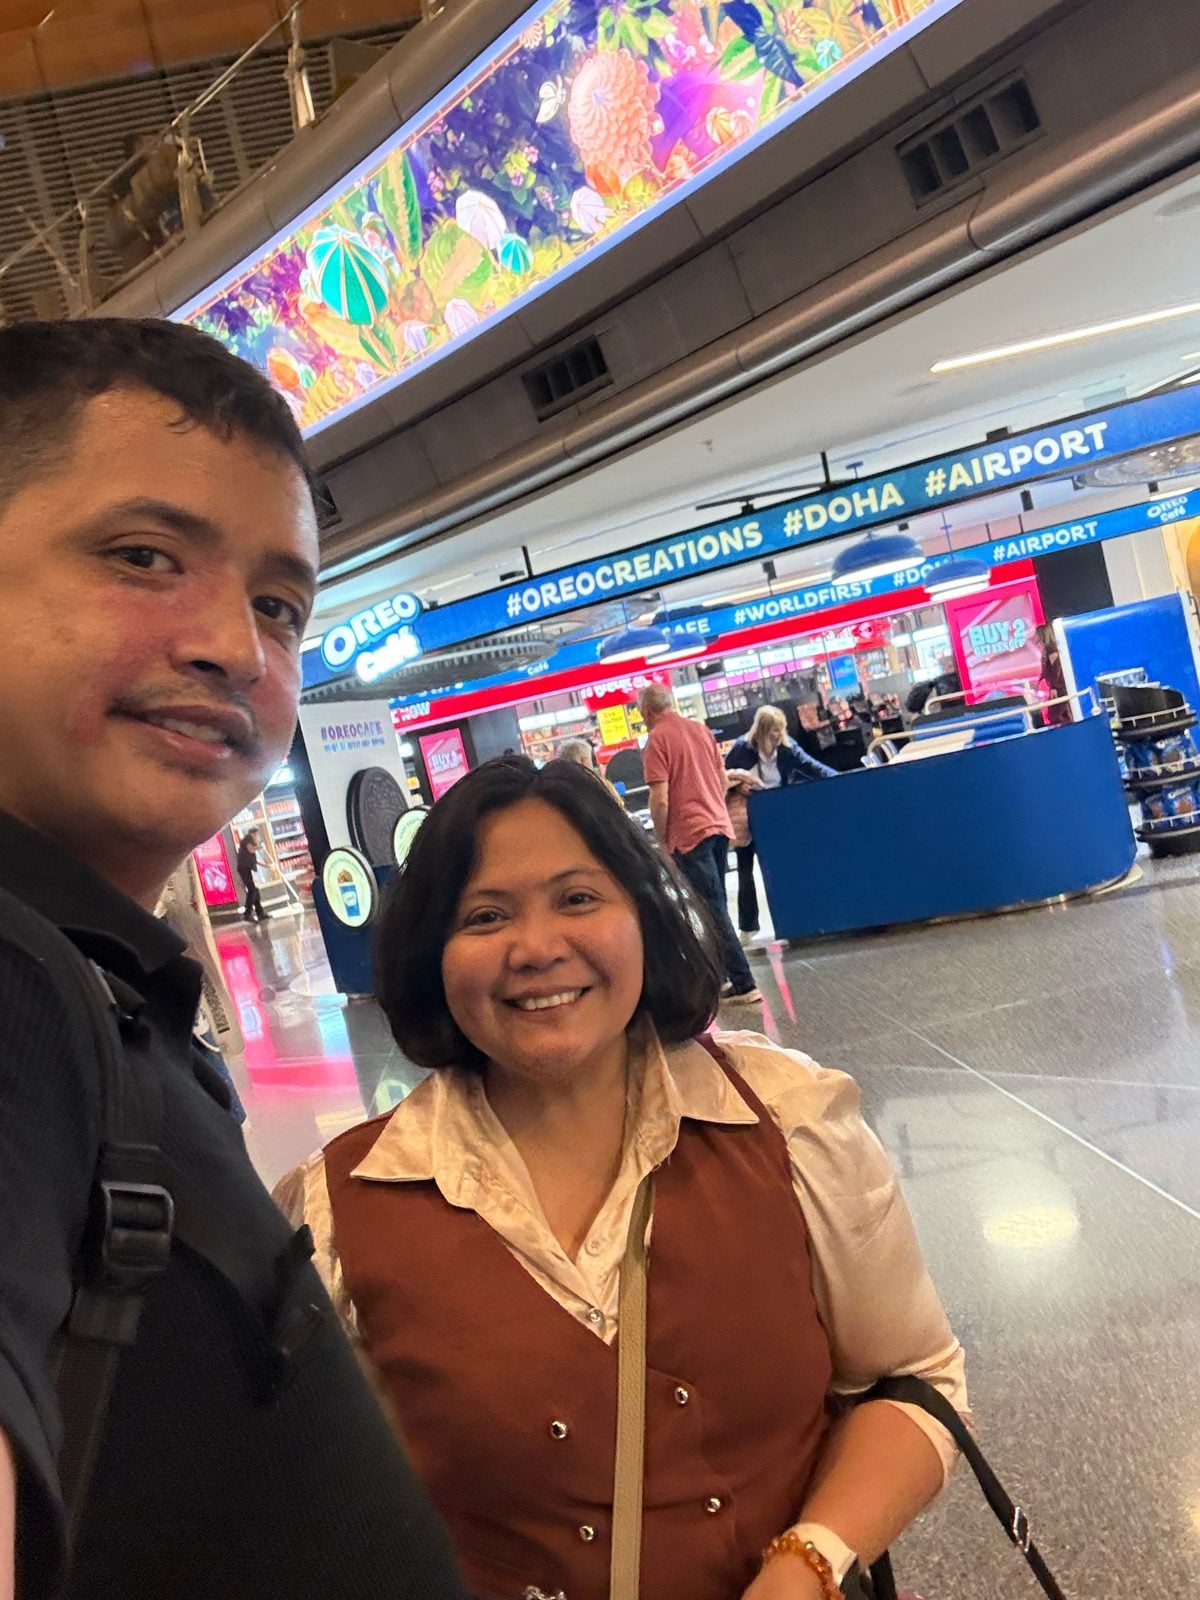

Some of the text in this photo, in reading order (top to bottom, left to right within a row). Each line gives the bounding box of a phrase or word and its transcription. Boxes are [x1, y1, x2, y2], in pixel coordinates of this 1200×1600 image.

[506, 422, 1108, 618] #OREOCREATIONS #DOHA #AIRPORT
[734, 580, 873, 625] #WORLDFIRST
[992, 521, 1098, 561] #AIRPORT
[322, 593, 417, 667] OREO
[969, 621, 1009, 646] BUY
